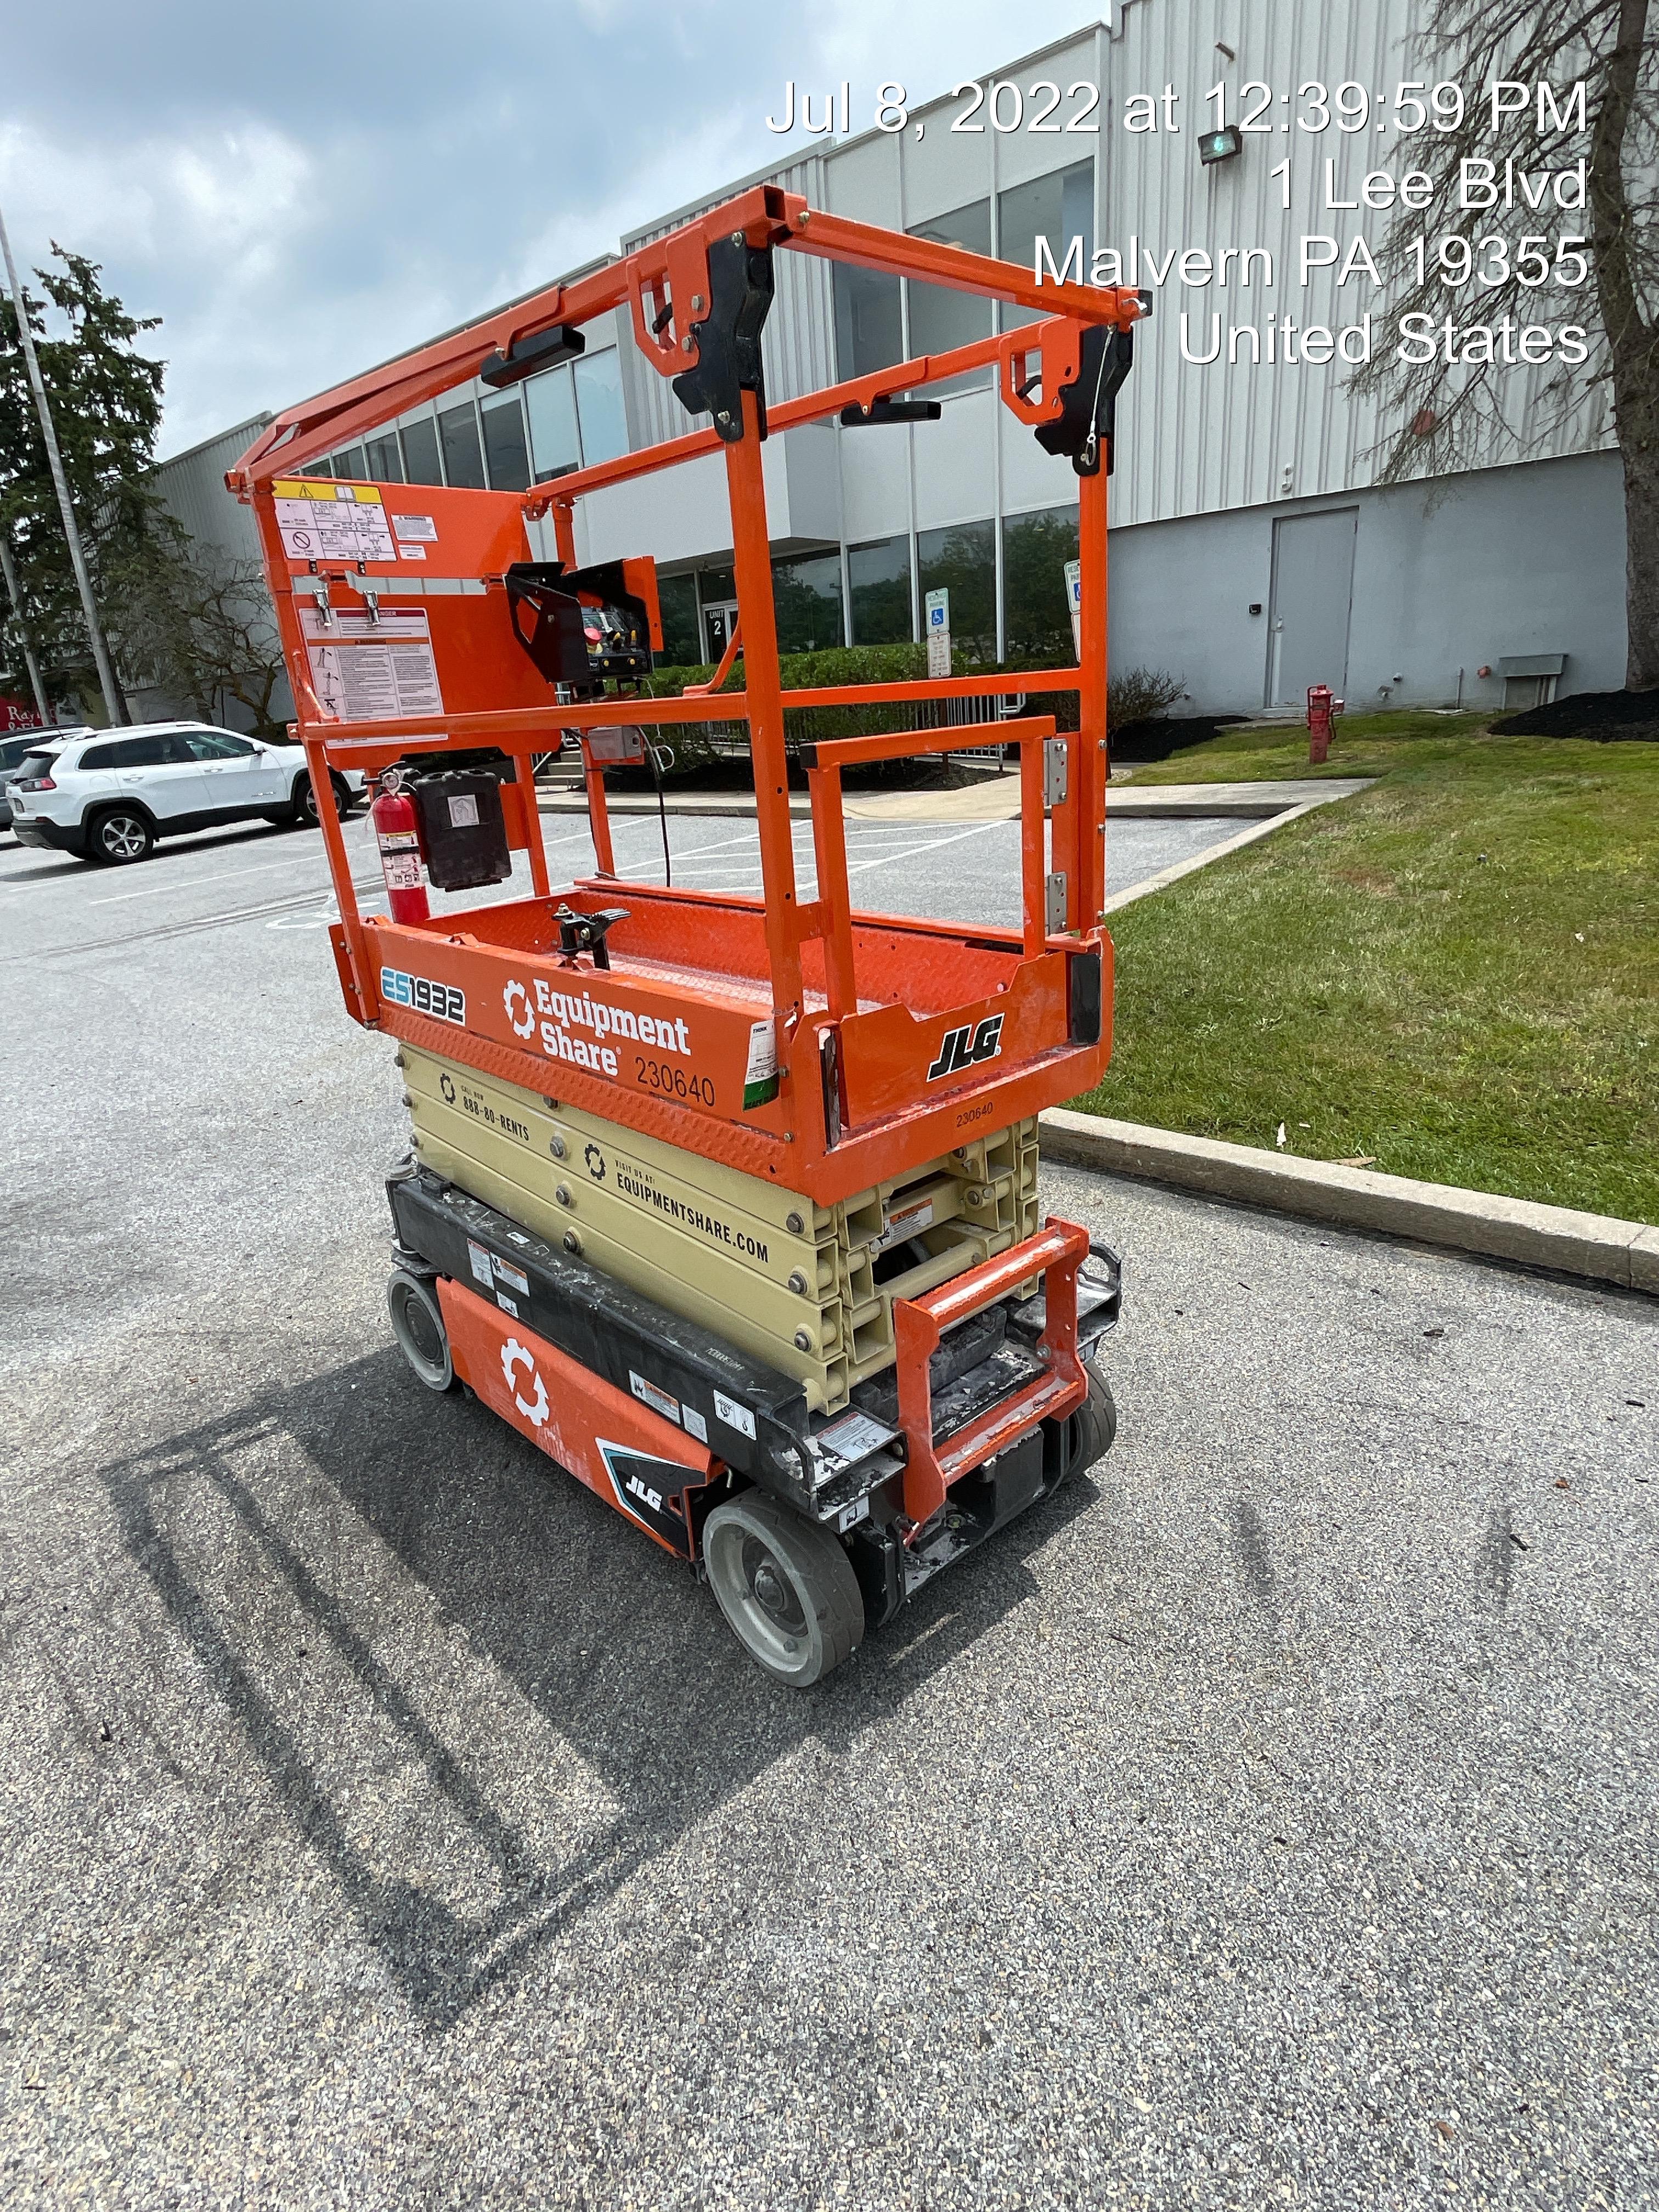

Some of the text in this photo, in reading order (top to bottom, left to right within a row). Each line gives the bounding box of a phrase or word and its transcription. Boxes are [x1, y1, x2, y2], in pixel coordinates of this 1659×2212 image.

[709, 609, 724, 619] UNIT
[714, 620, 721, 635] 2
[381, 966, 466, 1027] ES1932
[533, 979, 692, 1056] Equipment
[927, 1012, 1005, 1083] JLG
[635, 1056, 715, 1107] 230640
[463, 1096, 529, 1141] 888-80-RENTS
[956, 1101, 994, 1128] 230640
[615, 1159, 631, 1173] VISIT
[634, 1169, 643, 1179] US
[617, 1172, 769, 1263] EQUIPMENTSHARE.COM
[625, 1475, 663, 1512] JLG
